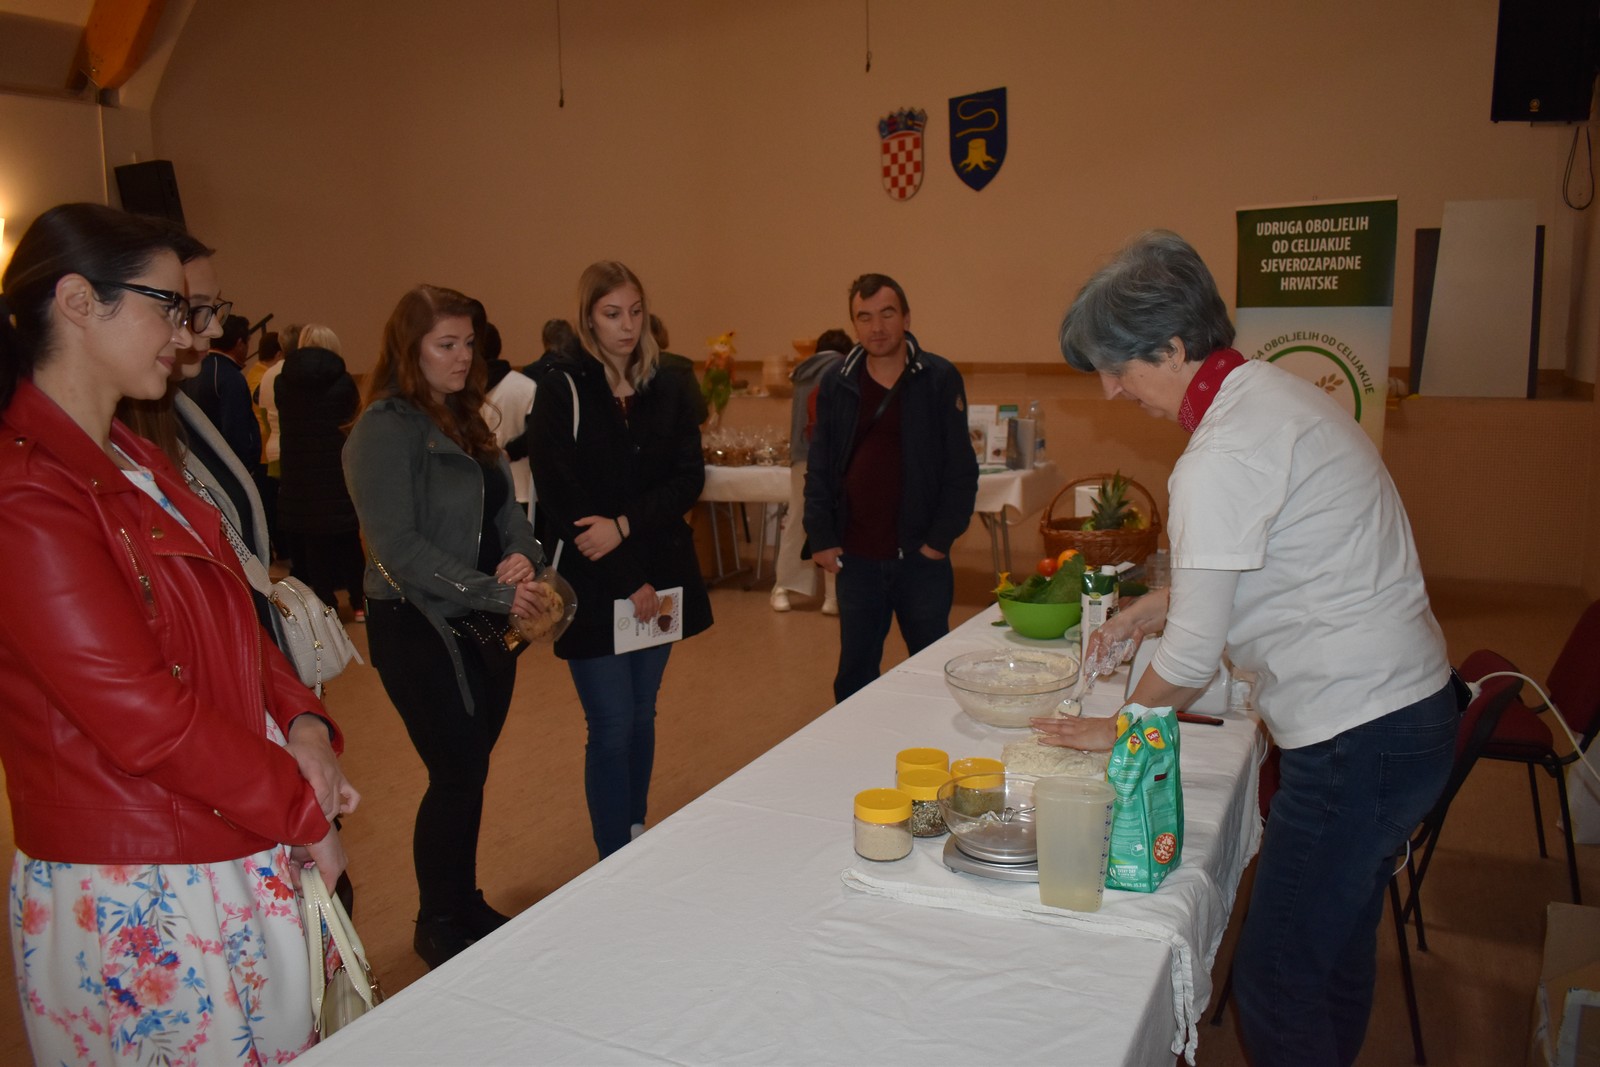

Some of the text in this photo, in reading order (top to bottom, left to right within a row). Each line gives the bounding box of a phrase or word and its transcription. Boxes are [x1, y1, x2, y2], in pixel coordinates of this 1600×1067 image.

[1256, 216, 1369, 236] UDRUGA OBOLJELIH
[1272, 236, 1351, 254] OD CELIJAKIJE
[1260, 255, 1362, 273] SJEVEROZAPADNE
[1280, 276, 1339, 291] HRVATSKE
[1264, 331, 1375, 395] OBOLJELIH OD CELIJAKIJE
